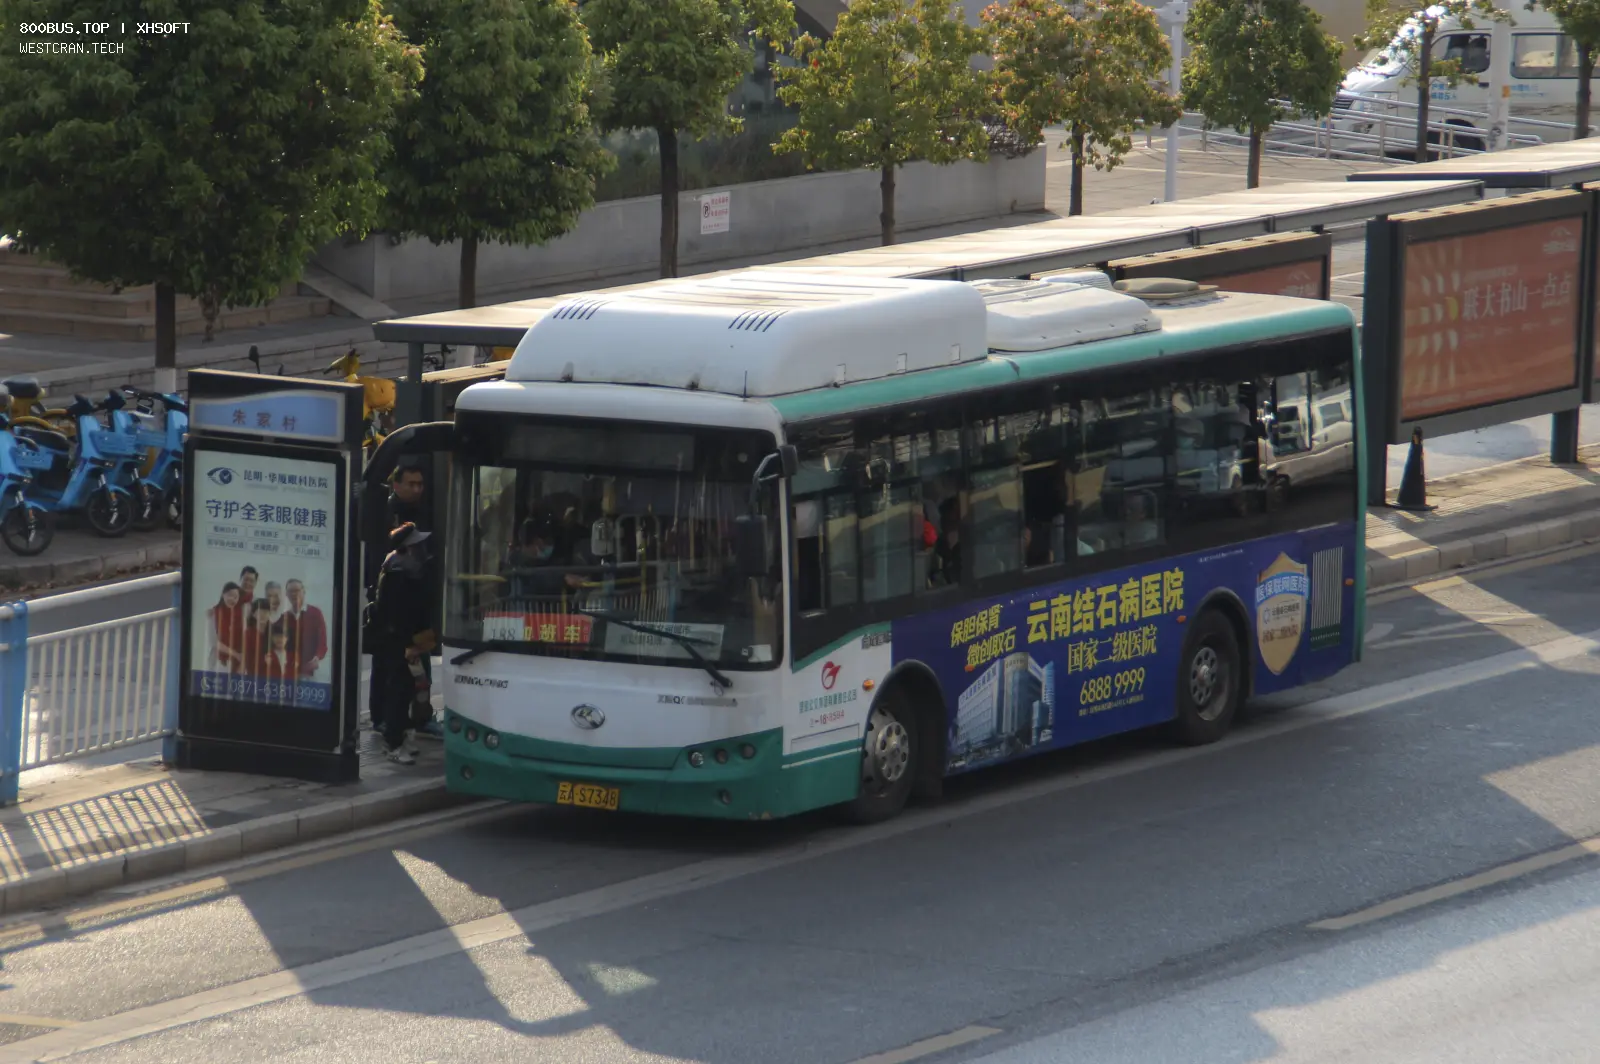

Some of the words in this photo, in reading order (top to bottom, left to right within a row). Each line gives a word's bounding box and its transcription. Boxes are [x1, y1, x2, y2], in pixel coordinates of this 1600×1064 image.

[233, 409, 297, 432] 朱家村
[206, 499, 328, 528] 守护全家眼健康
[951, 603, 1001, 648] 保胆保肾
[1027, 566, 1184, 644] 云南结石病医院
[967, 626, 1016, 667] 微创取石
[1067, 623, 1158, 675] 国家二级医院
[1079, 673, 1112, 705] 6888
[1114, 666, 1146, 696] 9999
